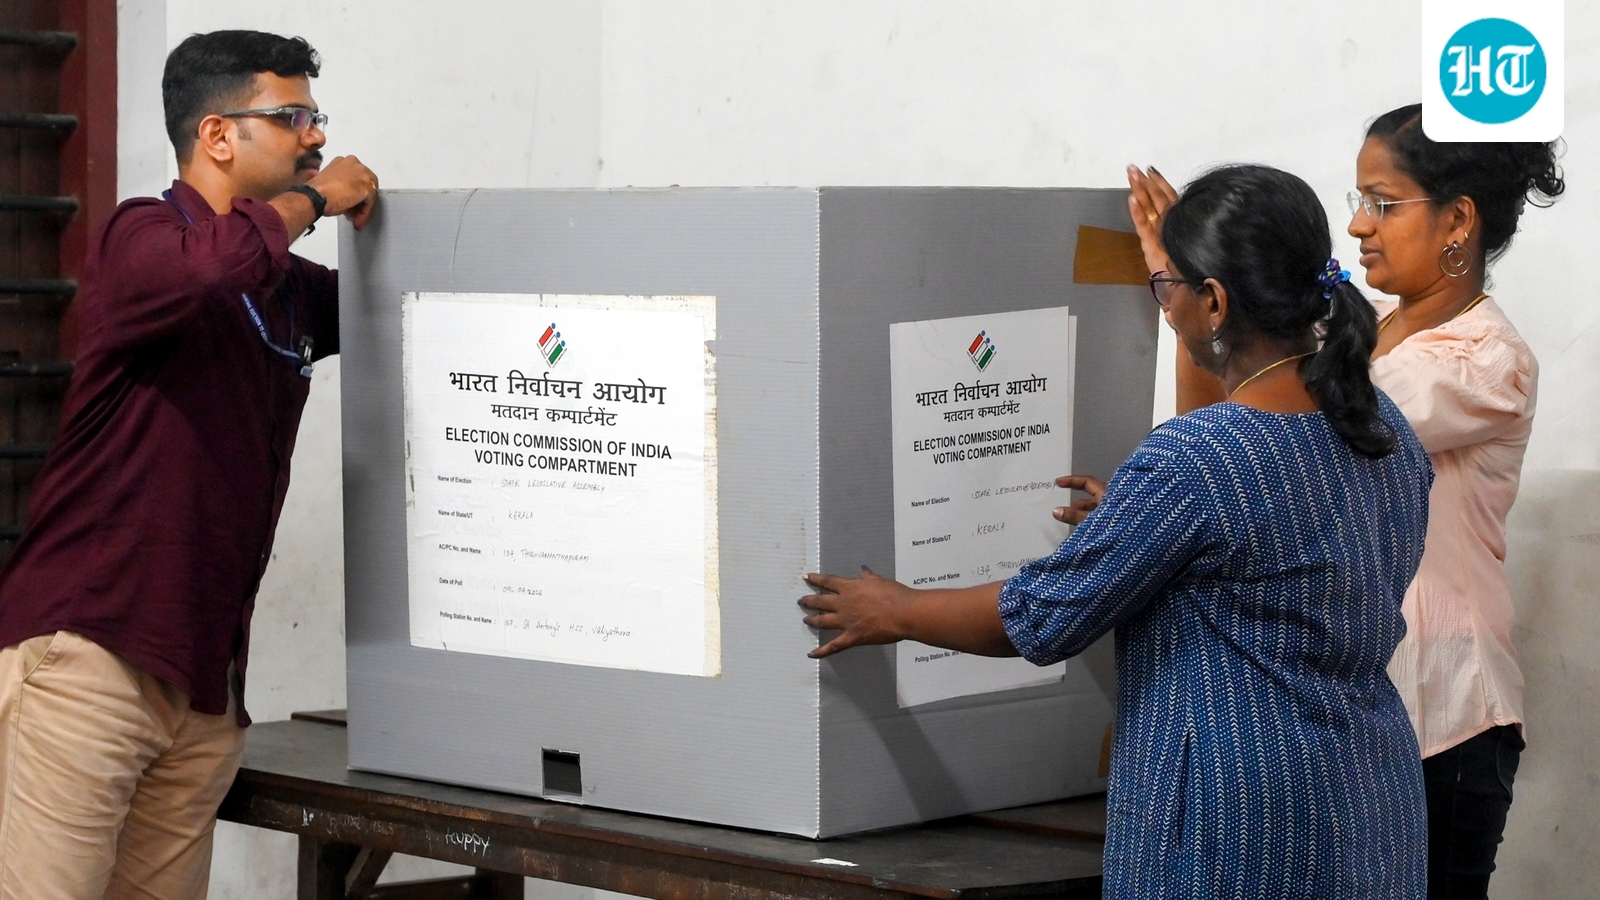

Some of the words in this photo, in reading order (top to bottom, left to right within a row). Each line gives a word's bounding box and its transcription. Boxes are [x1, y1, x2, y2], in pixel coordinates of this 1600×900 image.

[449, 371, 499, 393] भारत
[506, 369, 583, 400] निर्वाचन
[592, 377, 668, 405] आयोग
[915, 389, 949, 407] भारत
[953, 379, 1001, 403] निर्वाचन
[1005, 373, 1048, 395] आयोग
[490, 404, 540, 421] मतदान
[545, 406, 618, 427] कम्पार्टमेंट
[943, 408, 975, 423] मतदान
[977, 399, 1021, 419] कम्पार्टमेंट
[445, 427, 509, 446] ELECTION
[512, 433, 602, 454] COMMISSION
[607, 441, 627, 456] OF
[631, 443, 672, 460] INDIA
[913, 435, 956, 453] ELECTION
[958, 428, 1012, 446] COMMISSION
[1013, 427, 1026, 438] OF
[1027, 423, 1051, 436] INDIA
[932, 450, 966, 465] VOTING
[967, 441, 1032, 461] COMPARTMENT
[474, 449, 524, 467] VOTING
[527, 455, 637, 478] COMPARTMENT
[572, 481, 606, 493] ASSEMBLY
[931, 496, 950, 505] Election
[456, 511, 473, 519] State/UT
[508, 510, 534, 520] KERALA
[977, 522, 1005, 536] KERALA
[932, 534, 951, 544] State/UT
[912, 578, 928, 586] AC/PC
[440, 610, 452, 620] Polling
[453, 612, 466, 620] Station
